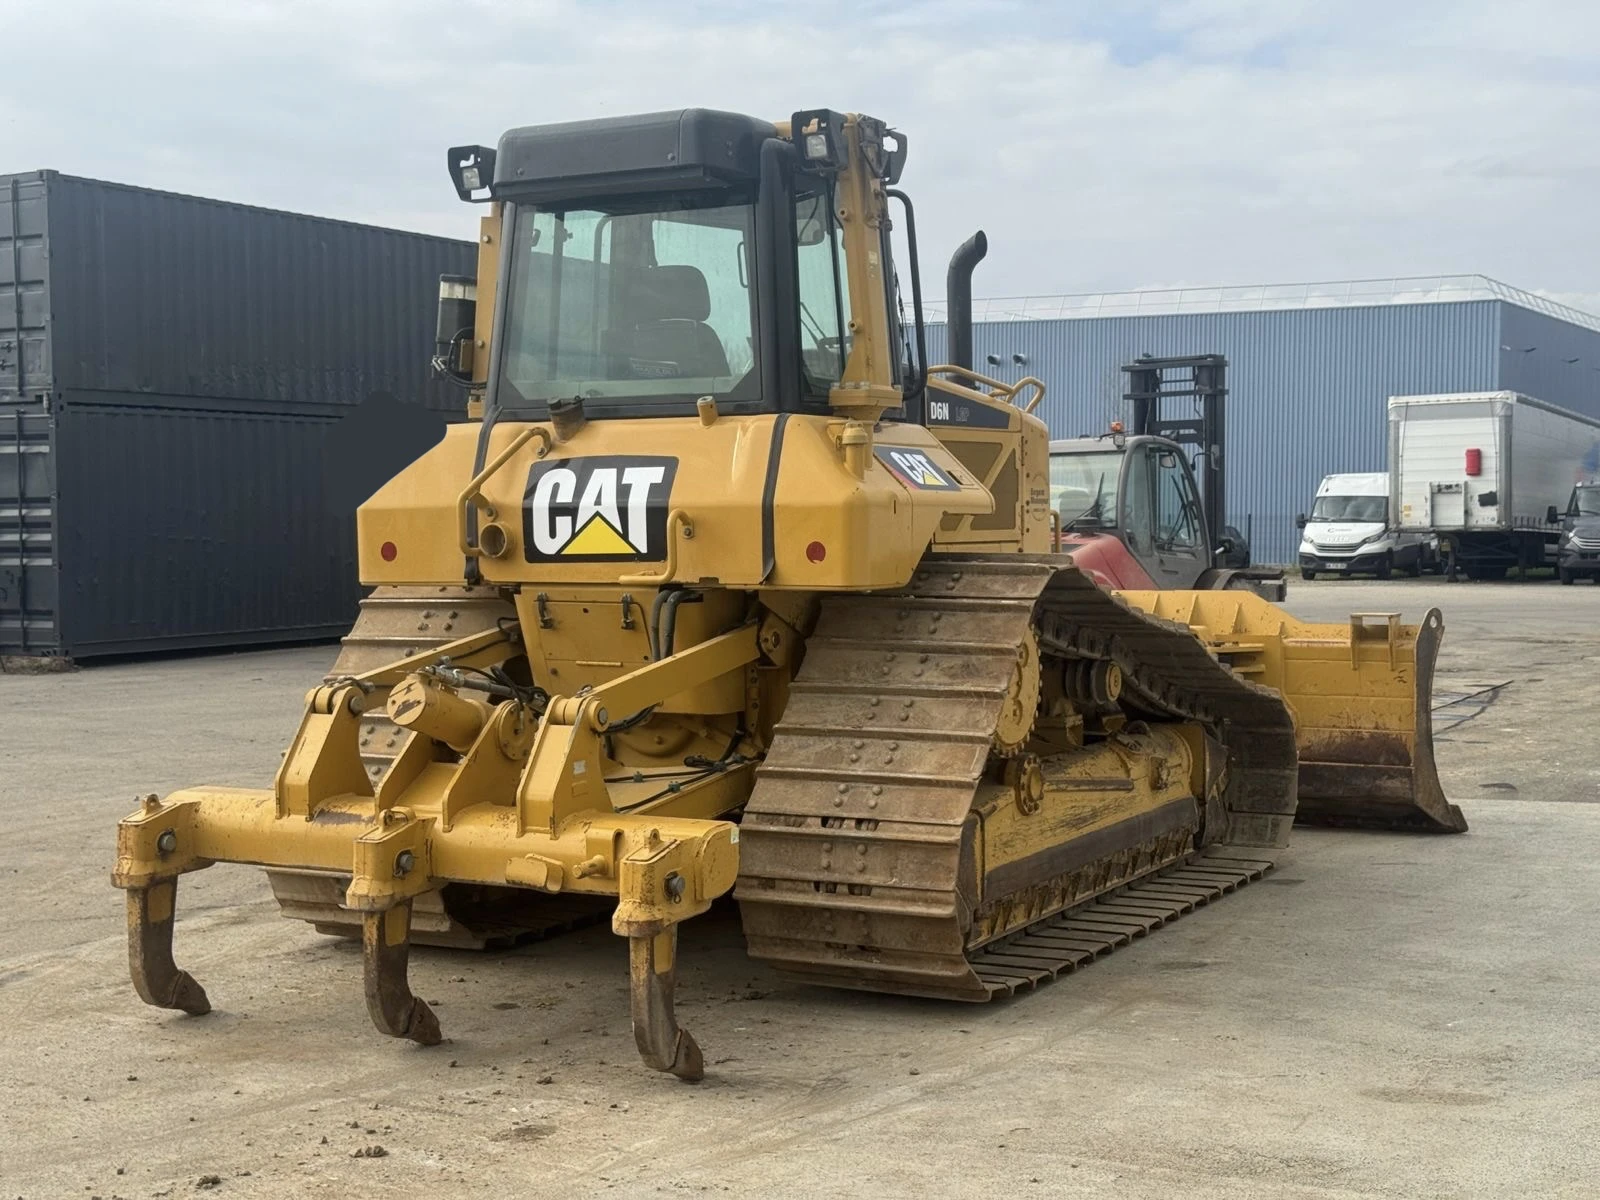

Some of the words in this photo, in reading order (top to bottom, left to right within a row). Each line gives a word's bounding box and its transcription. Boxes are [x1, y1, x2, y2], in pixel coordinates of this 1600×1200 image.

[930, 401, 950, 421] D6N
[890, 451, 949, 486] CAT
[532, 466, 665, 555] CAT
